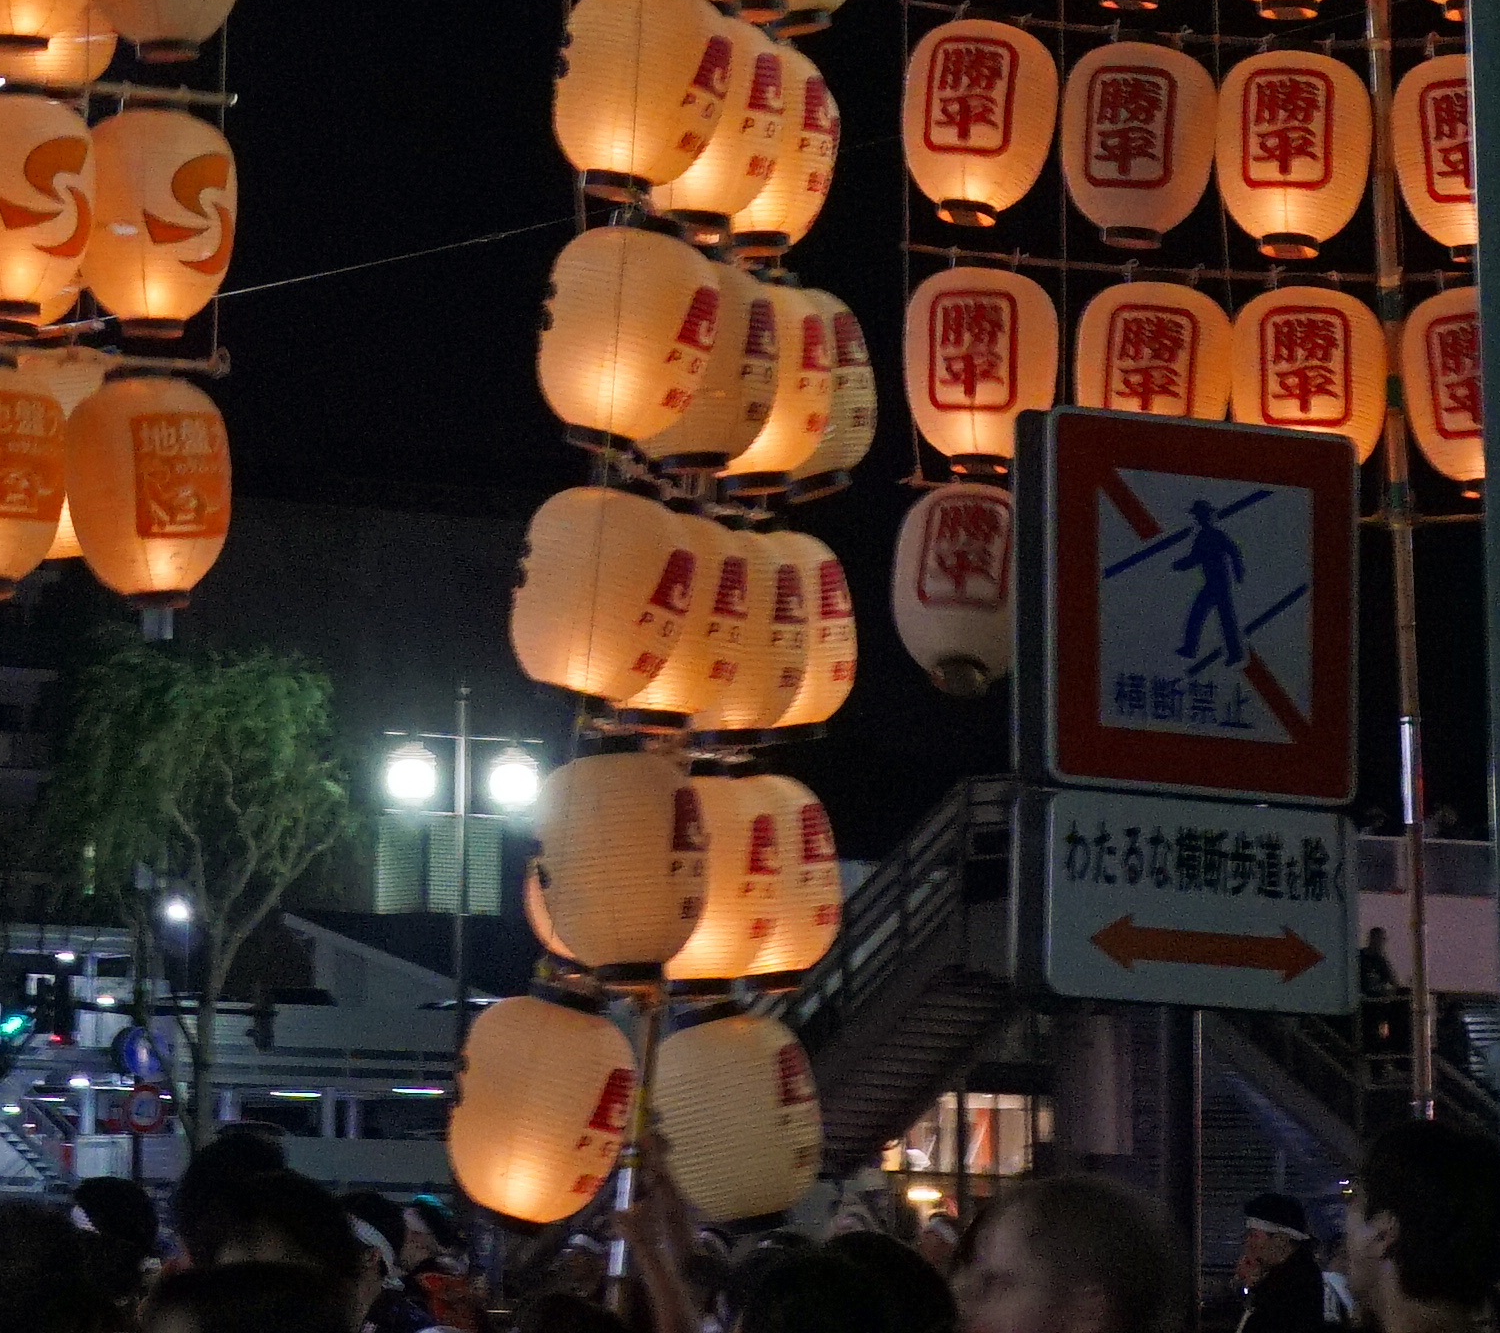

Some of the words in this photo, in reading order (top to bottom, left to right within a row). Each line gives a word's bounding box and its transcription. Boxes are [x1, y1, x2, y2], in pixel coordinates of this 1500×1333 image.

[935, 47, 1003, 142] 勝平
[1094, 79, 1164, 176] 勝平
[1253, 79, 1322, 176] 勝平
[940, 302, 1005, 398] 勝平
[1117, 316, 1186, 411] 勝平
[1272, 319, 1340, 413] 勝平
[1114, 673, 1254, 730] 横断禁止
